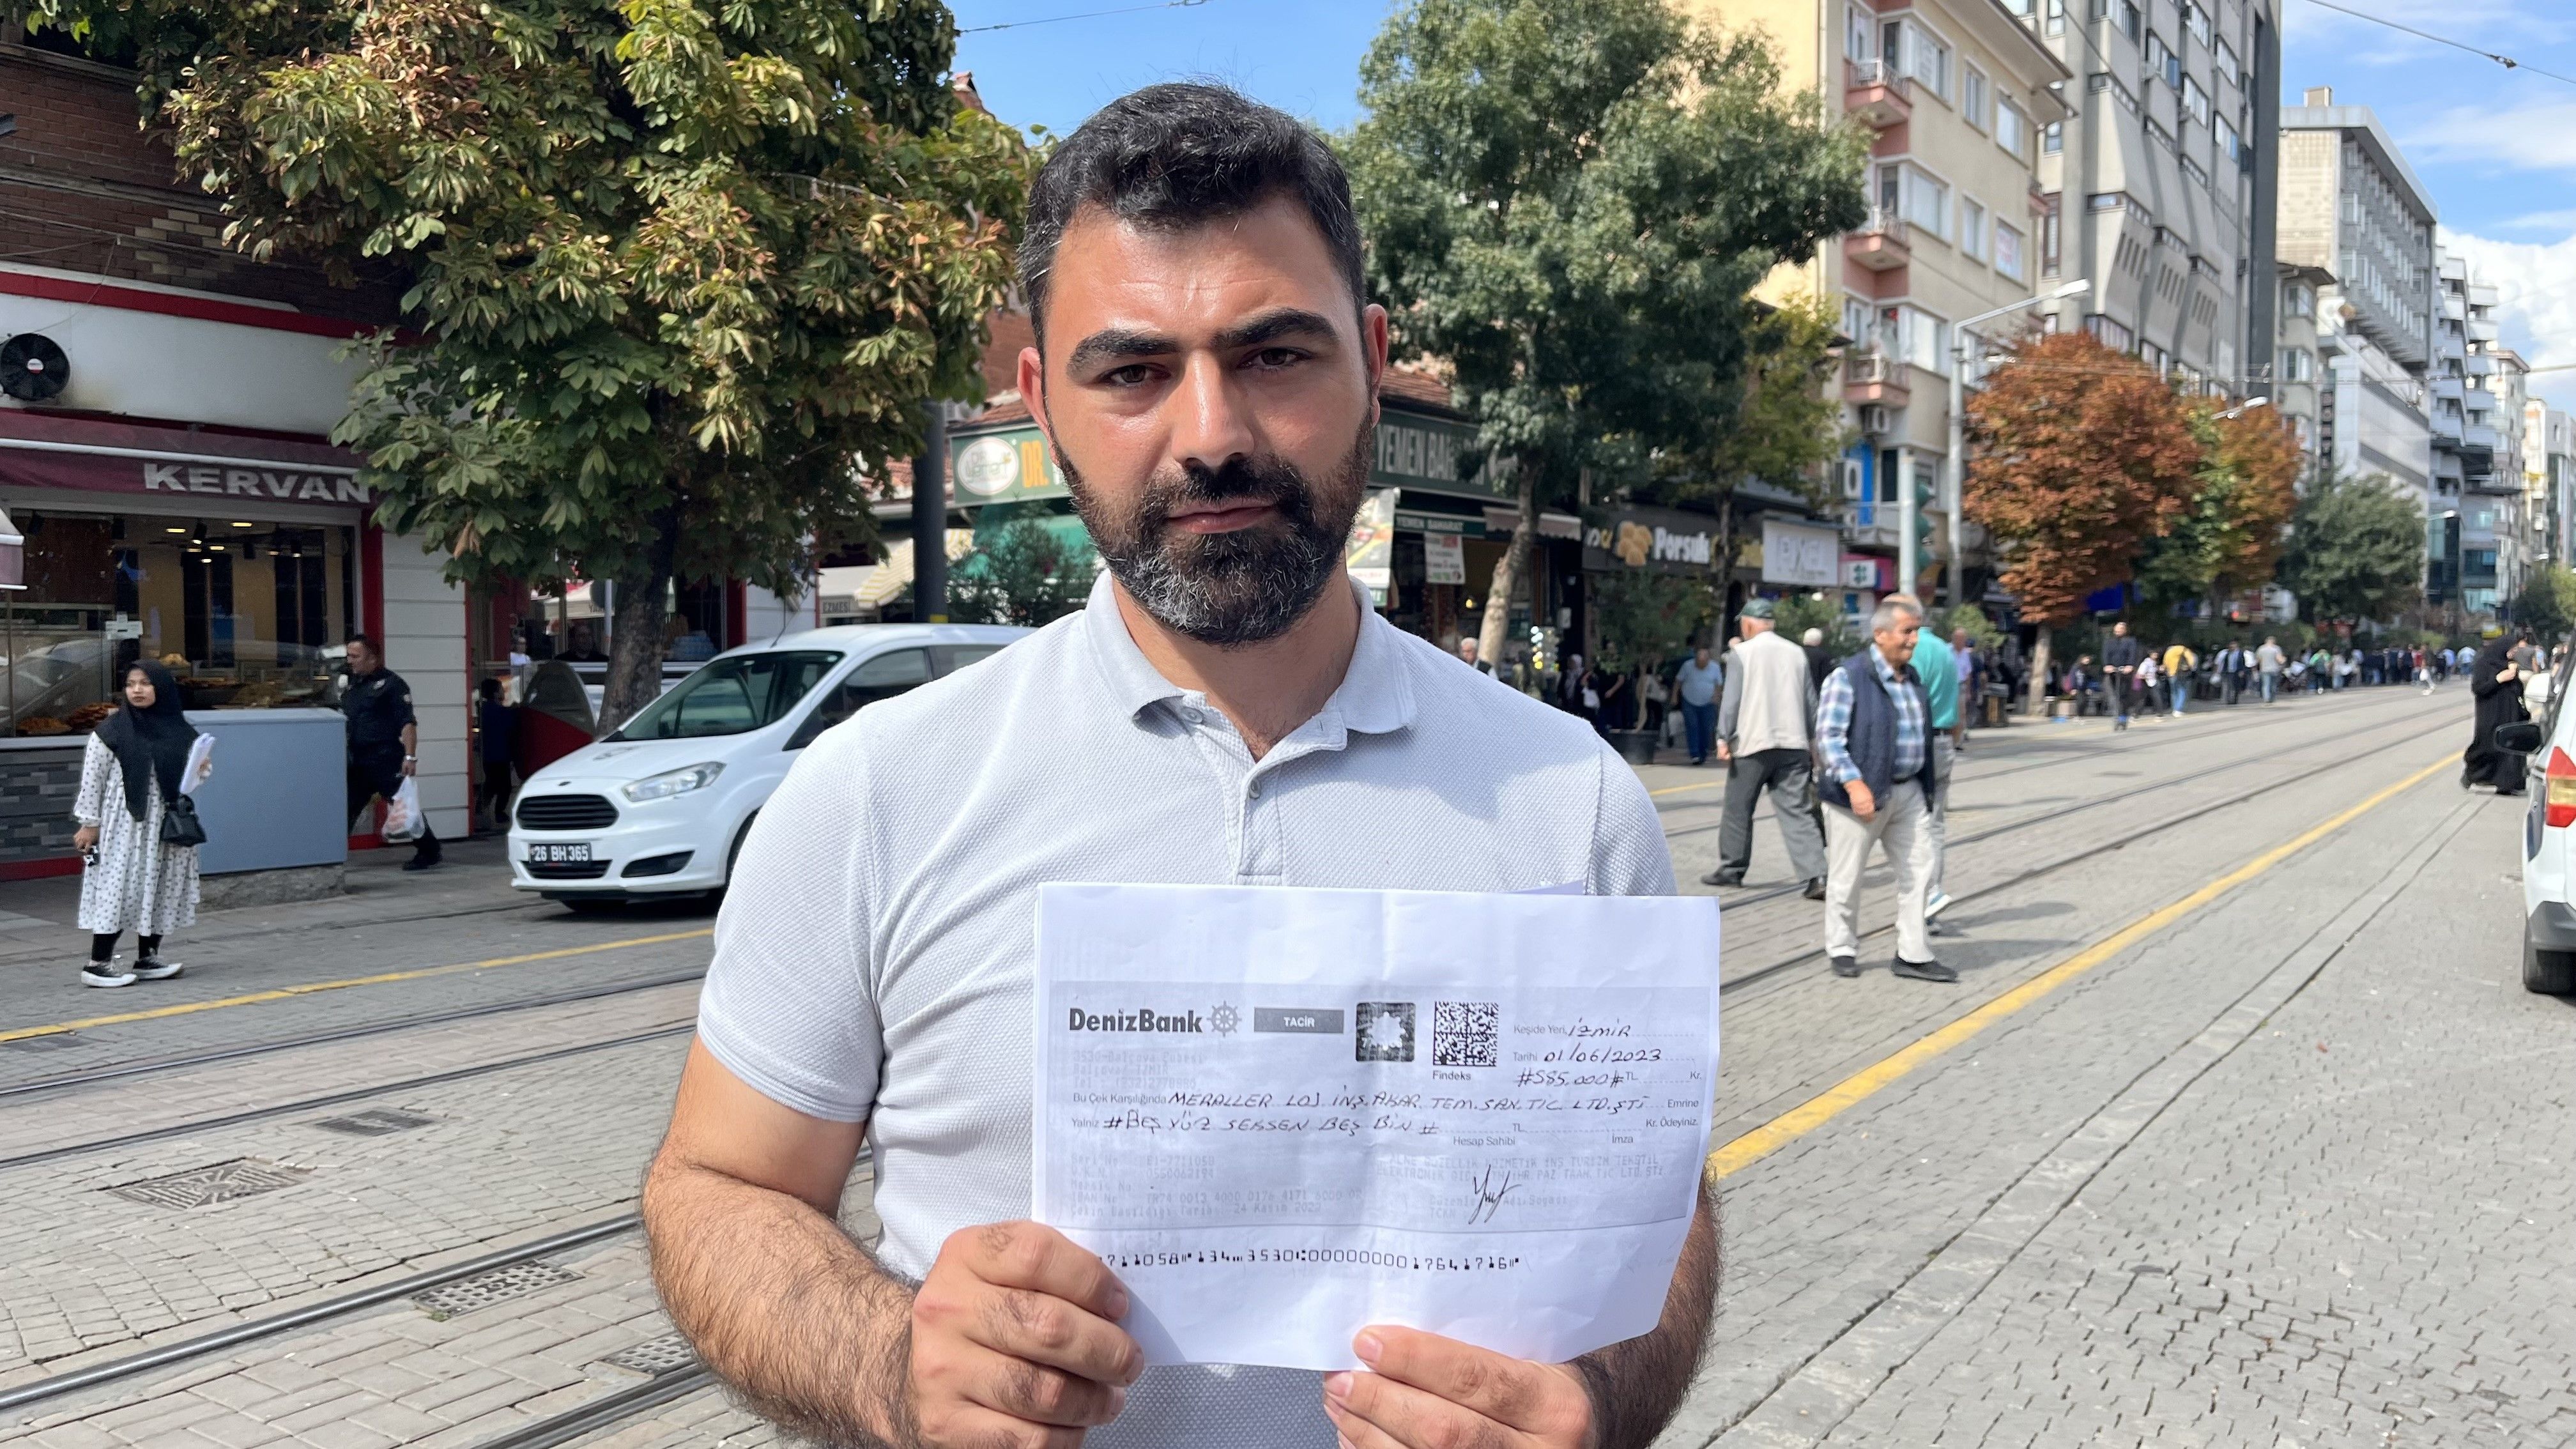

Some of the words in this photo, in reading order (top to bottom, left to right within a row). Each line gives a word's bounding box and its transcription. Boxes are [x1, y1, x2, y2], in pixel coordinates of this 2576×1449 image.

[1377, 424, 1425, 477] YEMEN
[1022, 440, 1050, 488] DR.
[144, 463, 370, 503] KERVAN
[534, 845, 548, 862] 26
[551, 845, 567, 862] BH
[568, 845, 588, 862] 365
[1069, 1008, 1203, 1034] DenizBank
[1544, 1042, 1662, 1064] 01/06/2023
[1432, 1071, 1471, 1082] Findeks
[1073, 1092, 1087, 1103] Bu
[1088, 1092, 1108, 1105] Çek
[1666, 1098, 1699, 1108] Emrine
[1453, 1135, 1484, 1147] Hesap
[1485, 1135, 1516, 1146] Sahibi
[1611, 1133, 1634, 1144] İmza
